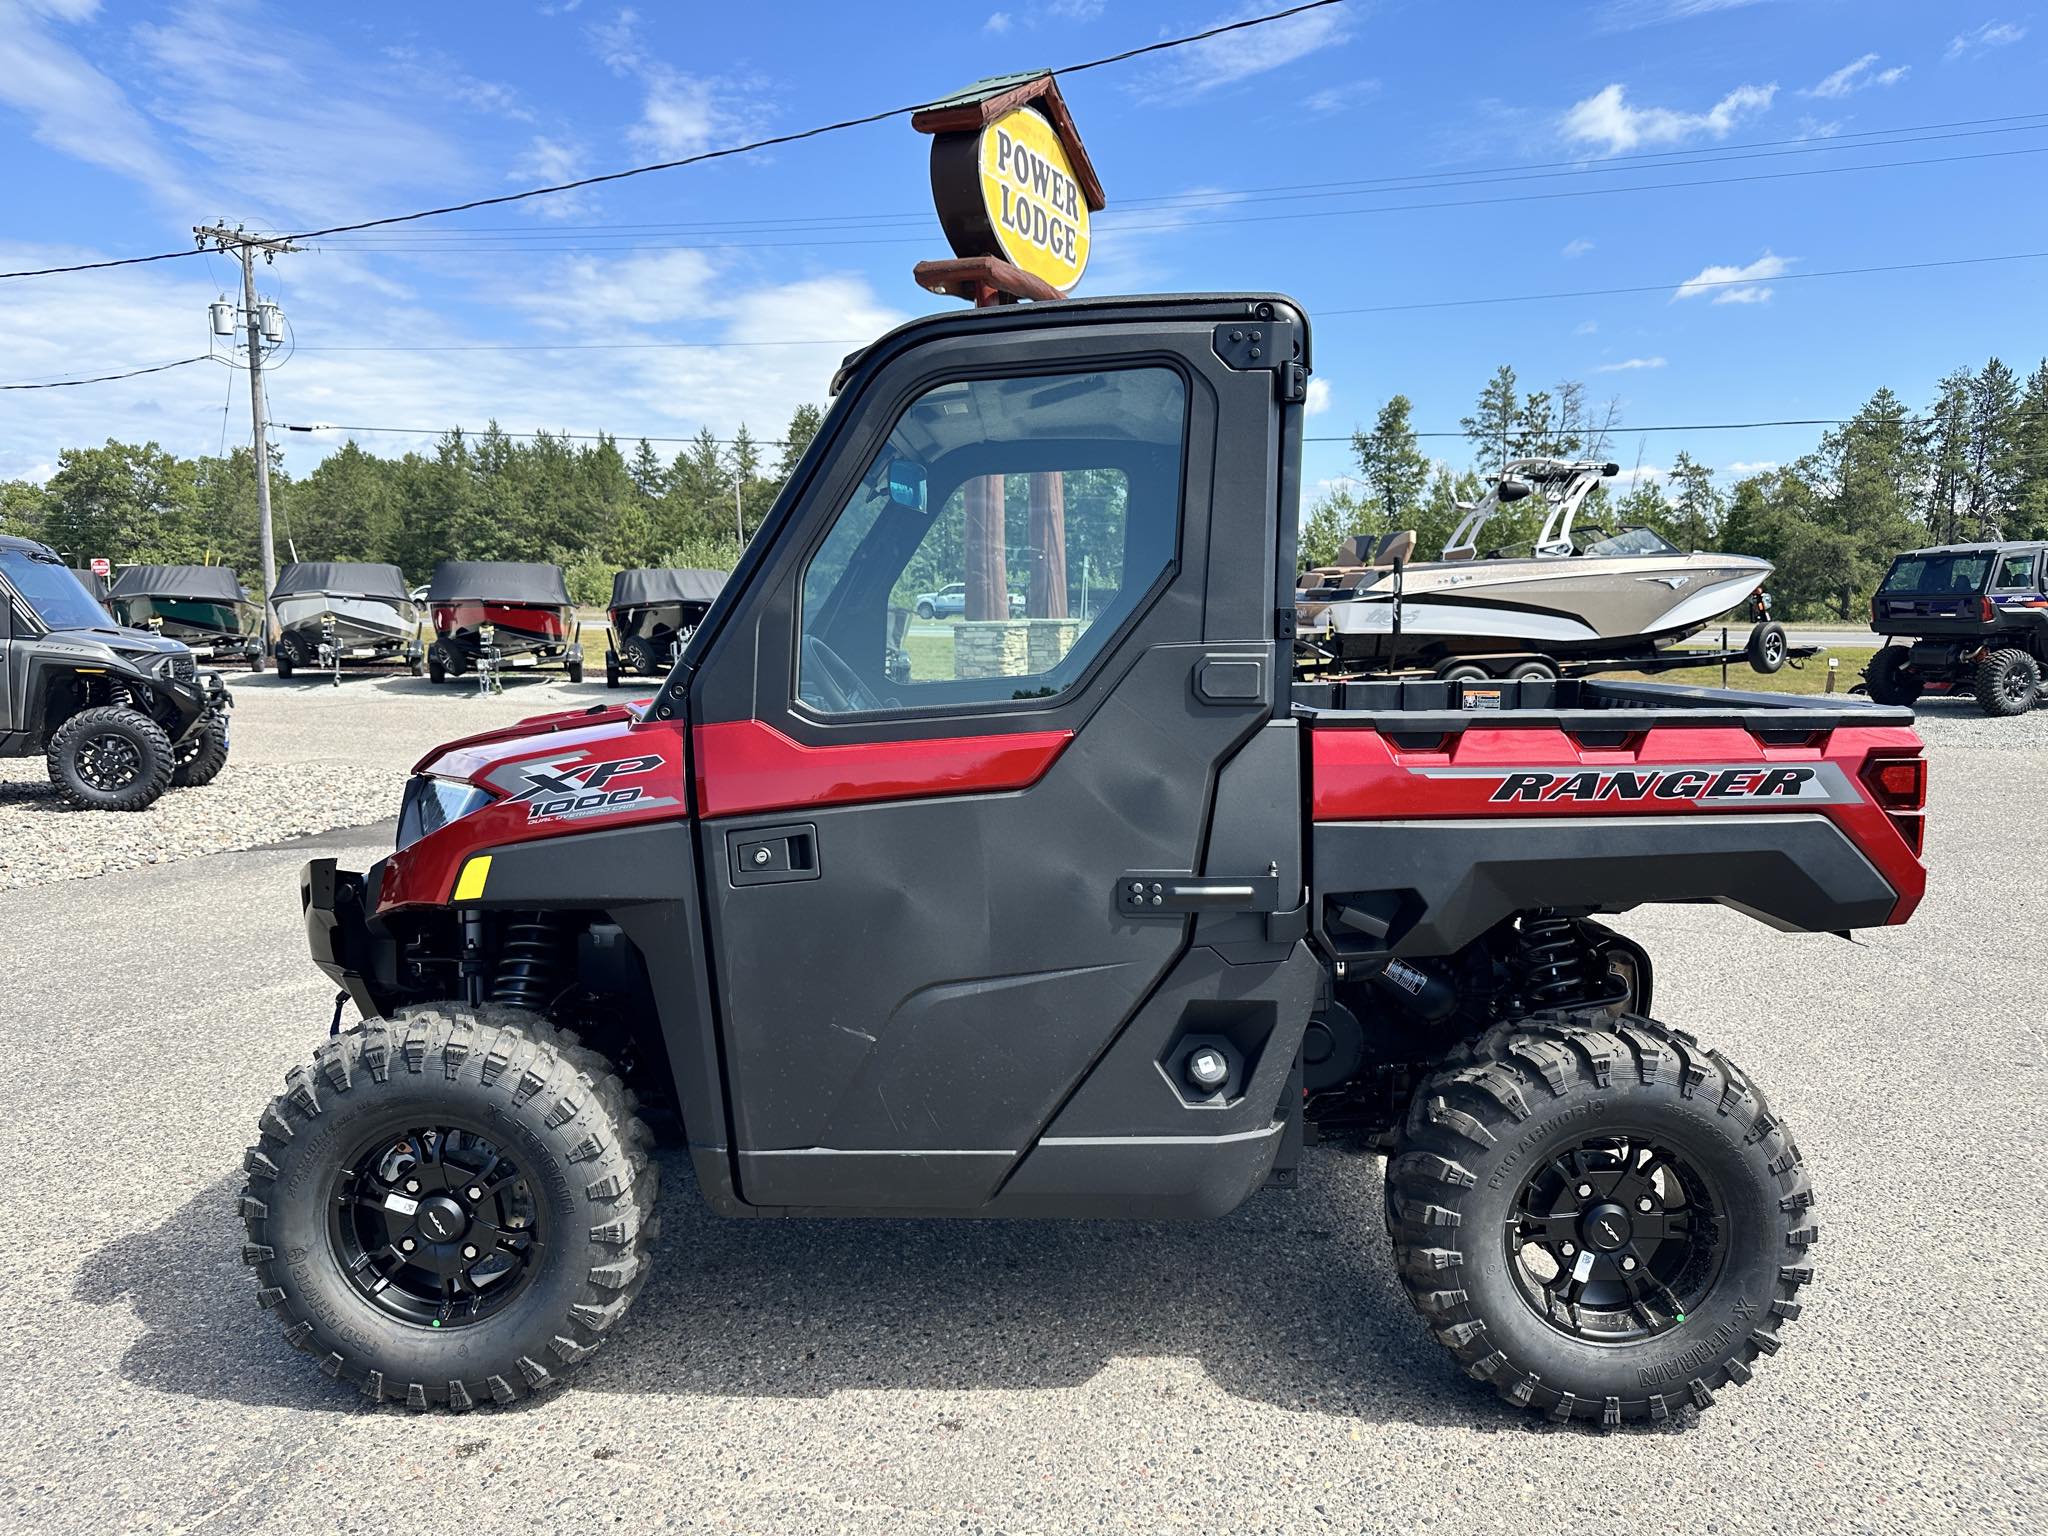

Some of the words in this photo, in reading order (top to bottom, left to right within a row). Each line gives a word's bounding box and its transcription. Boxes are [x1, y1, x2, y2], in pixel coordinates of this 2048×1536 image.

[997, 130, 1079, 222] POWER
[1001, 184, 1077, 264] LODGE
[496, 754, 667, 807] XP
[527, 786, 643, 821] 1000
[1488, 767, 1817, 802] RANGER
[527, 816, 554, 825] DUAL
[555, 807, 613, 821] OVERHEAD
[613, 803, 637, 812] CAM
[1487, 1151, 1520, 1190] PRO
[1518, 1104, 1593, 1152] ARMOR
